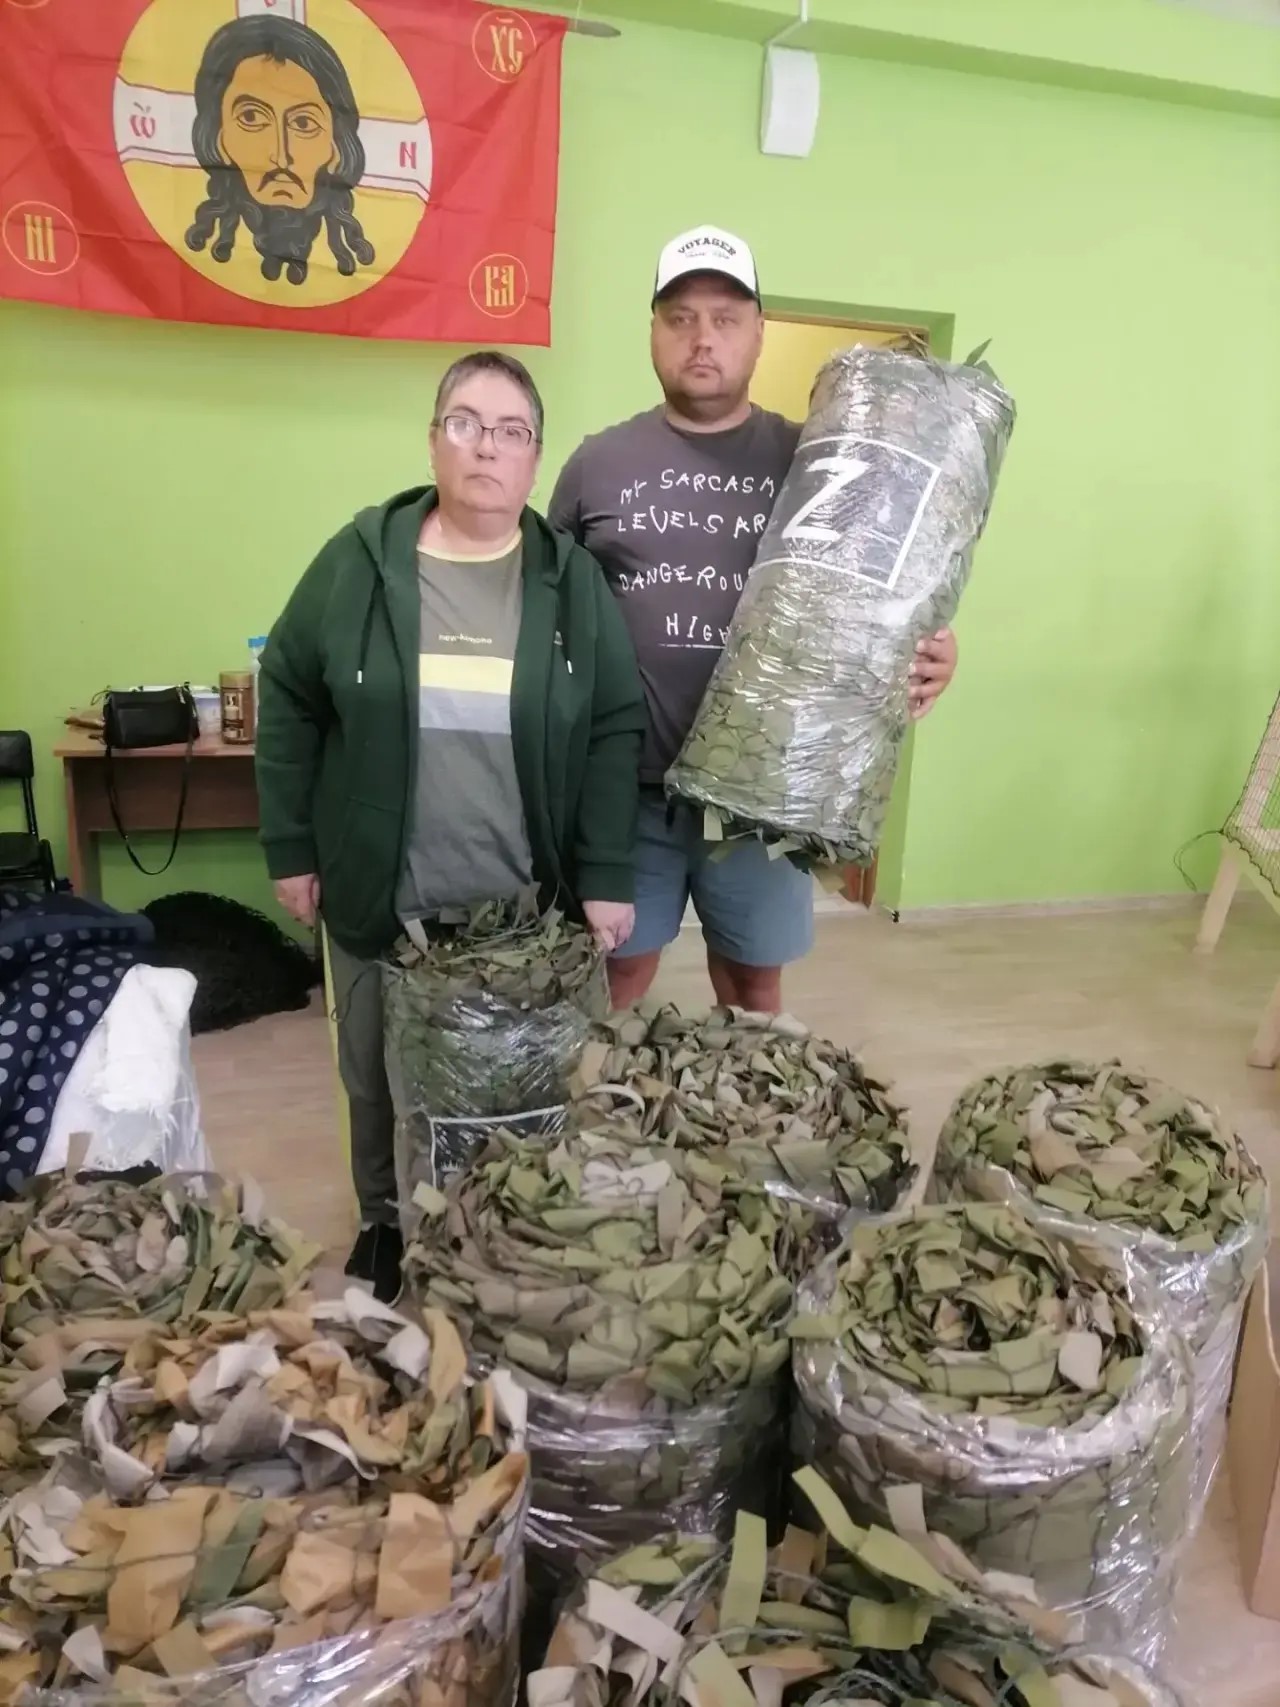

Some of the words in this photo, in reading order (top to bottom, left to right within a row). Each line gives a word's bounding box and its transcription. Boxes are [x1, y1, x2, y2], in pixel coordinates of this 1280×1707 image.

[677, 237, 737, 256] VOYAGER
[620, 479, 647, 504] MY
[659, 468, 775, 498] SARCASM
[781, 456, 872, 543] Z
[617, 505, 723, 534] LEVELS
[733, 513, 766, 538] AR
[619, 562, 743, 592] DANGEROU
